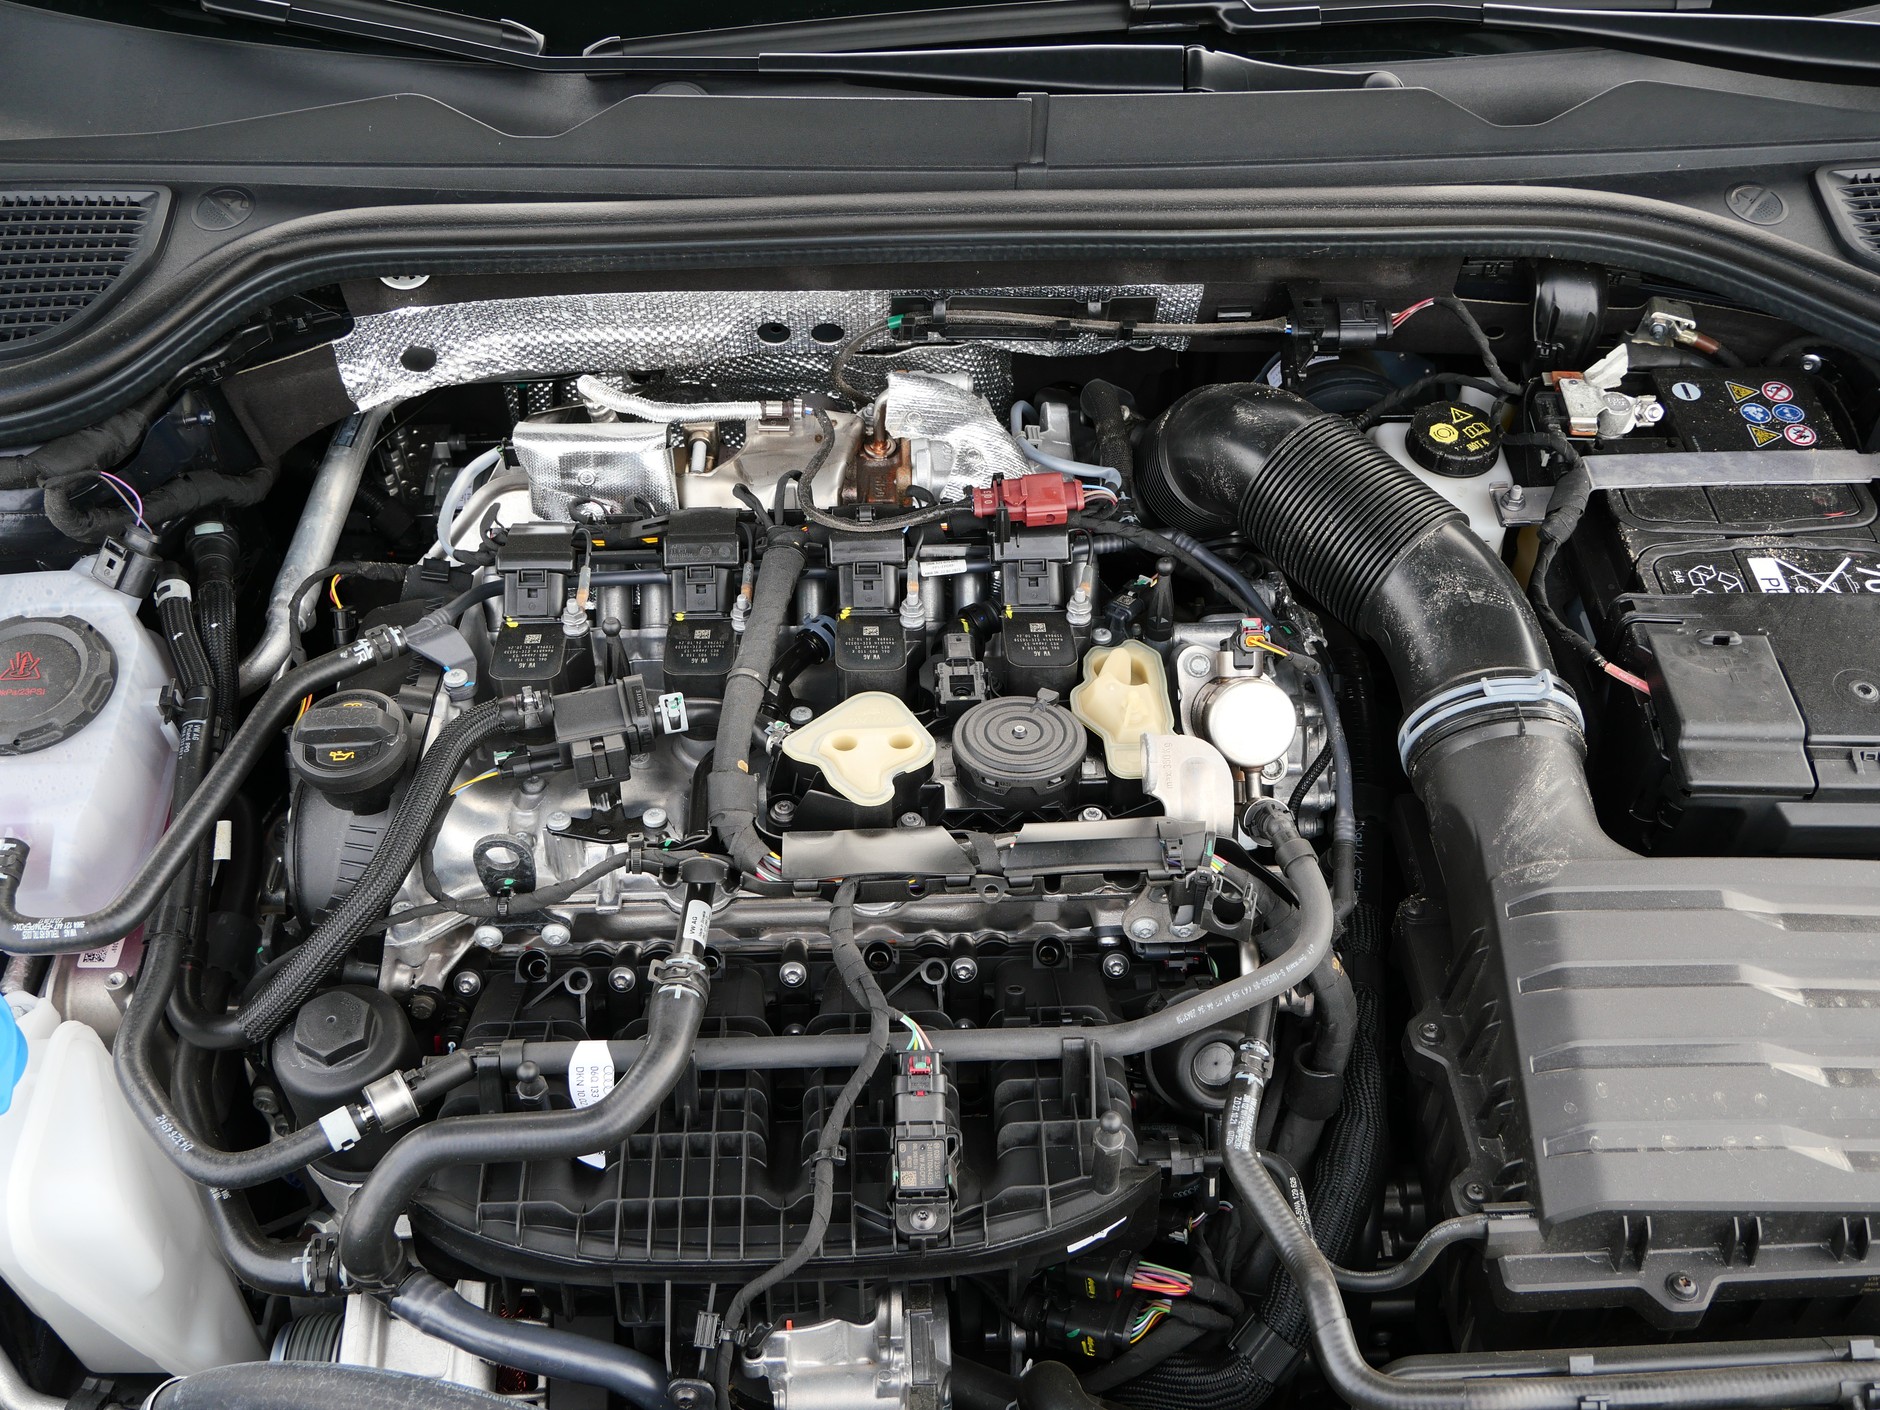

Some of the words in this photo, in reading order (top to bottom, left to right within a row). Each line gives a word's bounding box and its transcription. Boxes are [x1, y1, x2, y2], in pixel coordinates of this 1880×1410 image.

[1466, 439, 1482, 452] DOT
[185, 724, 193, 741] Poland
[192, 733, 200, 741] AG
[692, 916, 698, 924] AG
[575, 1066, 585, 1086] DKN
[590, 1066, 599, 1083] 06Q
[591, 1086, 599, 1098] 133
[920, 1153, 925, 1162] VW
[1291, 1189, 1300, 1199] 129
